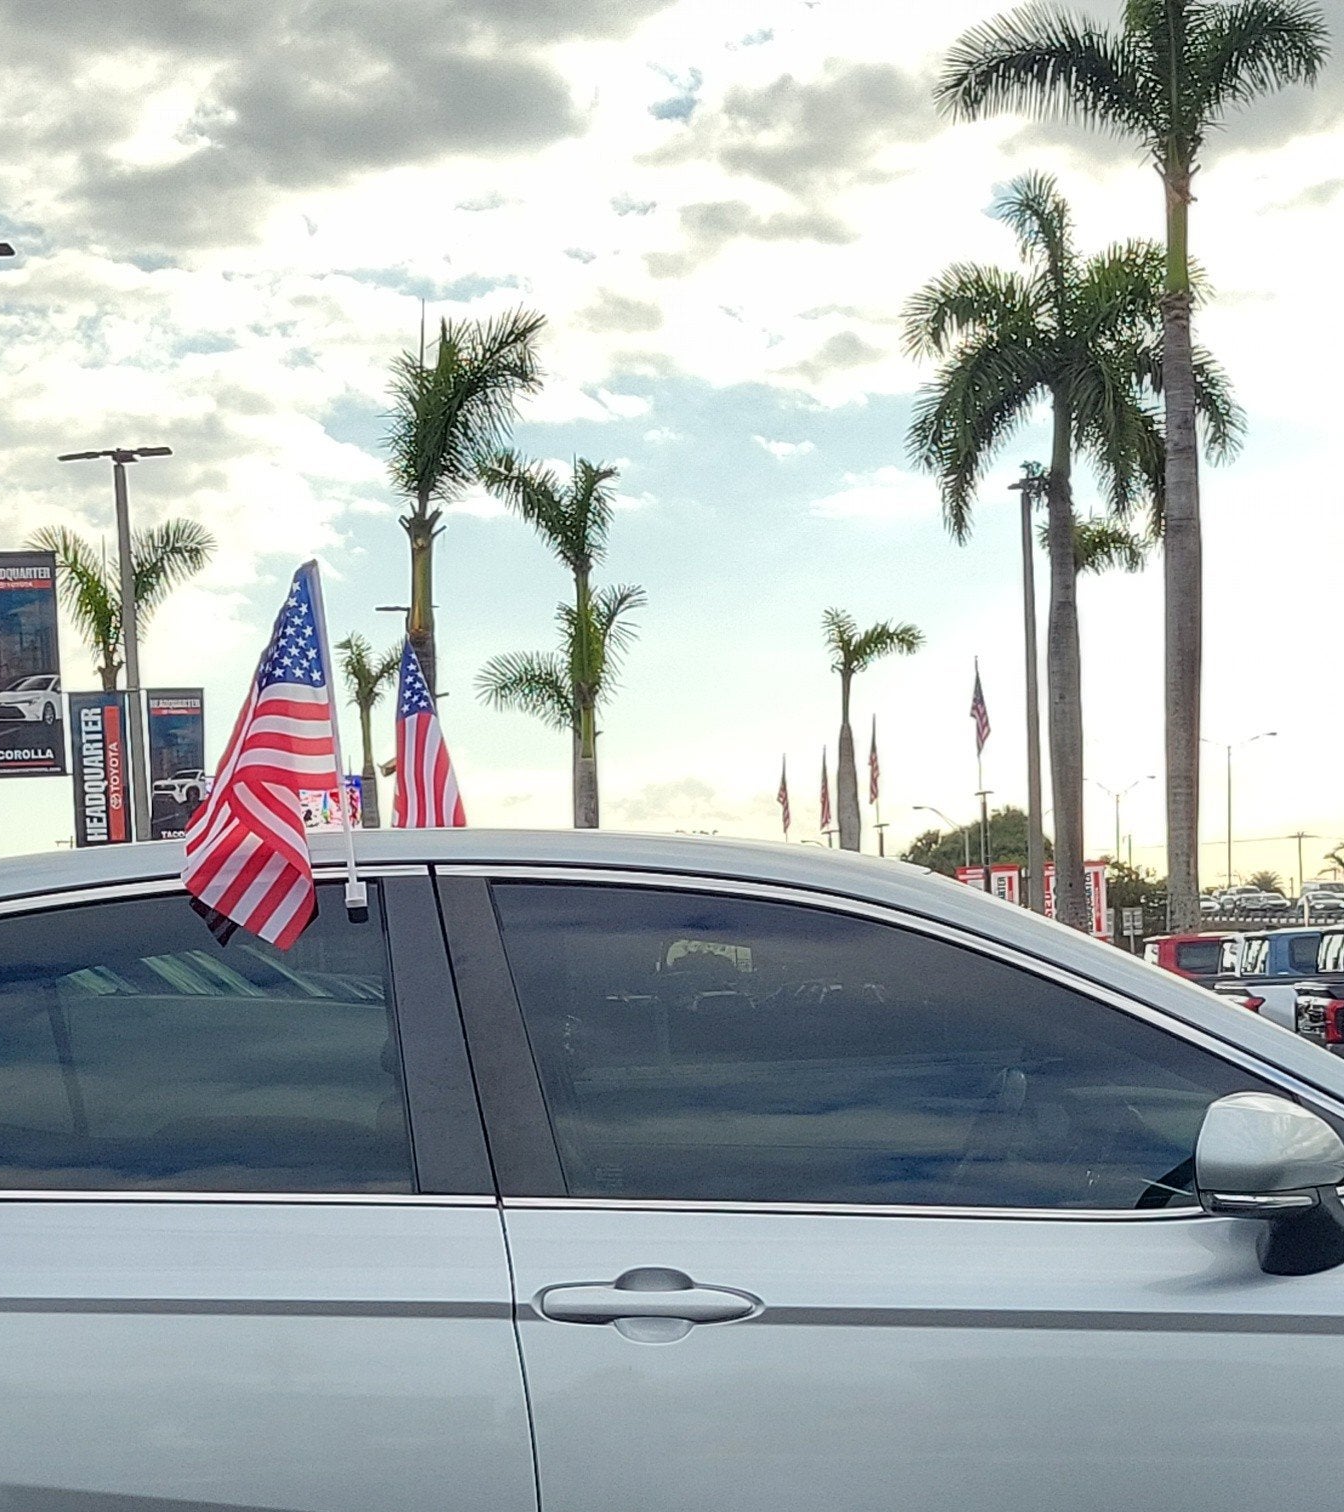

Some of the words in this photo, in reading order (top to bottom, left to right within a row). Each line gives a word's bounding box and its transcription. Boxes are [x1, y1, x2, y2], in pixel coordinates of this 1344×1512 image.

[81, 708, 108, 841] HEADQUARTER
[108, 742, 120, 792] TOYOTA
[160, 831, 186, 839] TACO
